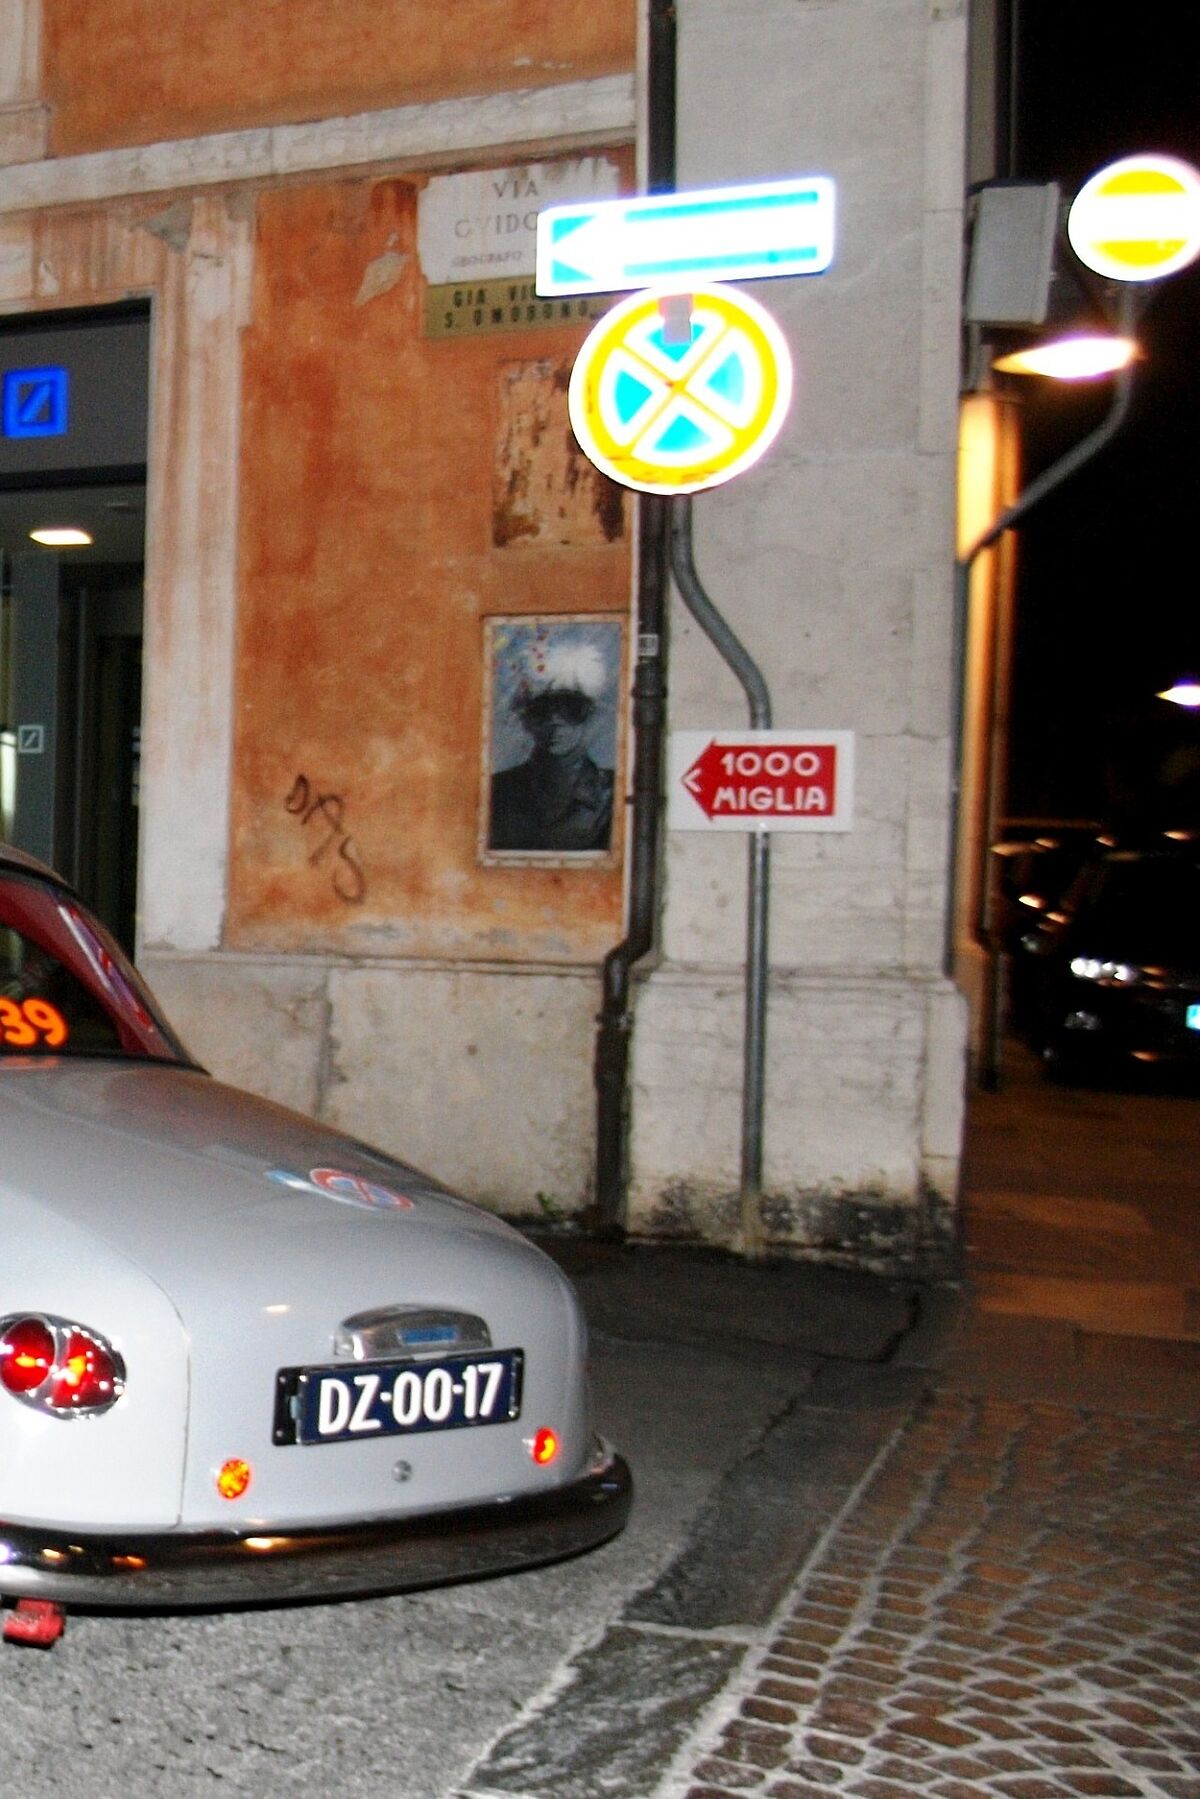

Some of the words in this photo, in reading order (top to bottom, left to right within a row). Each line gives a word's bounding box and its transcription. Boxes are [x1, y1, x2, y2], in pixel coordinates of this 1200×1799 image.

[492, 180, 539, 198] VIA
[721, 751, 820, 777] 1000
[711, 786, 827, 811] MIGLIA
[317, 1362, 504, 1436] DZ-00-17
